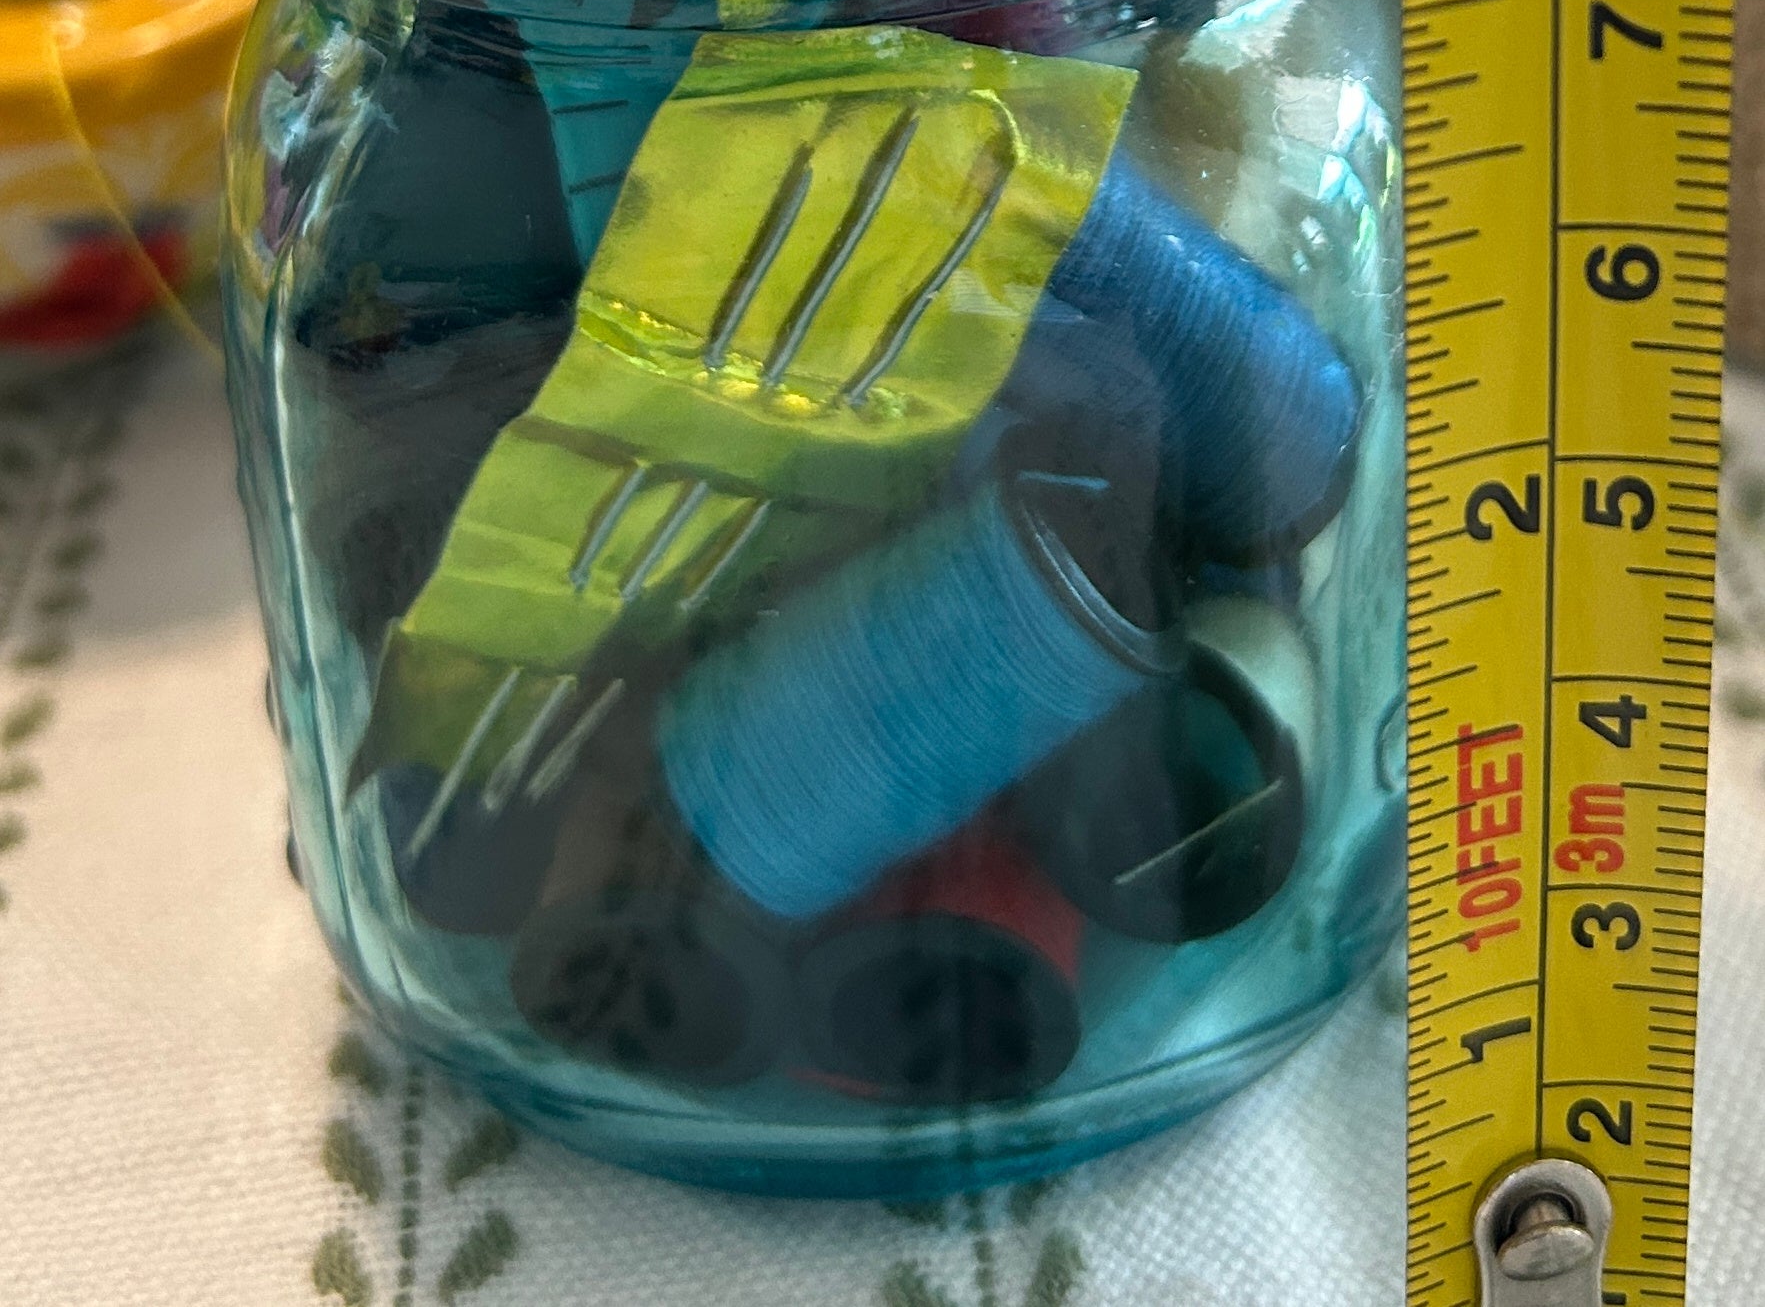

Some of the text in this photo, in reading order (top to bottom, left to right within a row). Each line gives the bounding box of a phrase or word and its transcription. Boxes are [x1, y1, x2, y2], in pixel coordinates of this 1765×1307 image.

[1589, 0, 1665, 61] 7
[1584, 244, 1661, 303] 6
[1464, 474, 1542, 541] 2
[1582, 476, 1656, 533] 5
[1578, 694, 1648, 749] 4
[1554, 783, 1626, 874] 3m
[1571, 901, 1642, 951] 3
[1461, 1017, 1533, 1065] 1
[1566, 1097, 1633, 1147] 2
